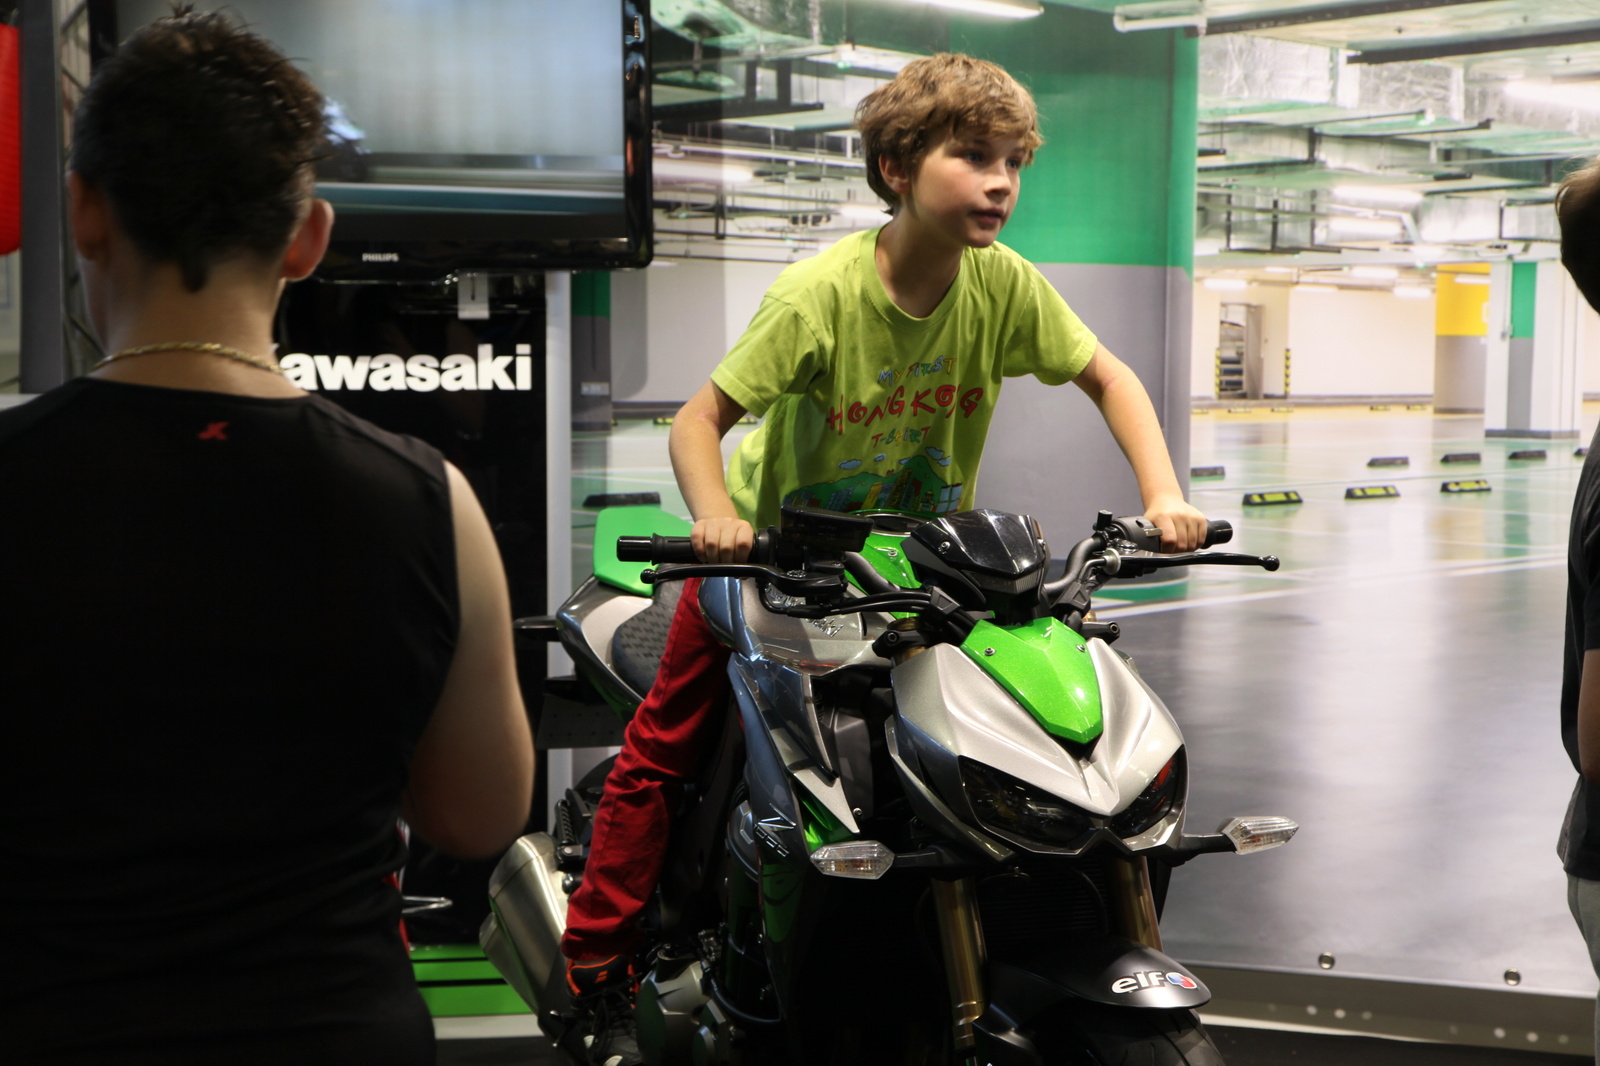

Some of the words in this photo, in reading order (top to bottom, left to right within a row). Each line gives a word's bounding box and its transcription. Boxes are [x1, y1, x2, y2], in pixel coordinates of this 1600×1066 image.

[362, 252, 399, 262] PHILIPS
[272, 343, 532, 392] awasaki
[877, 367, 905, 387] MY
[1111, 971, 1165, 994] elf
